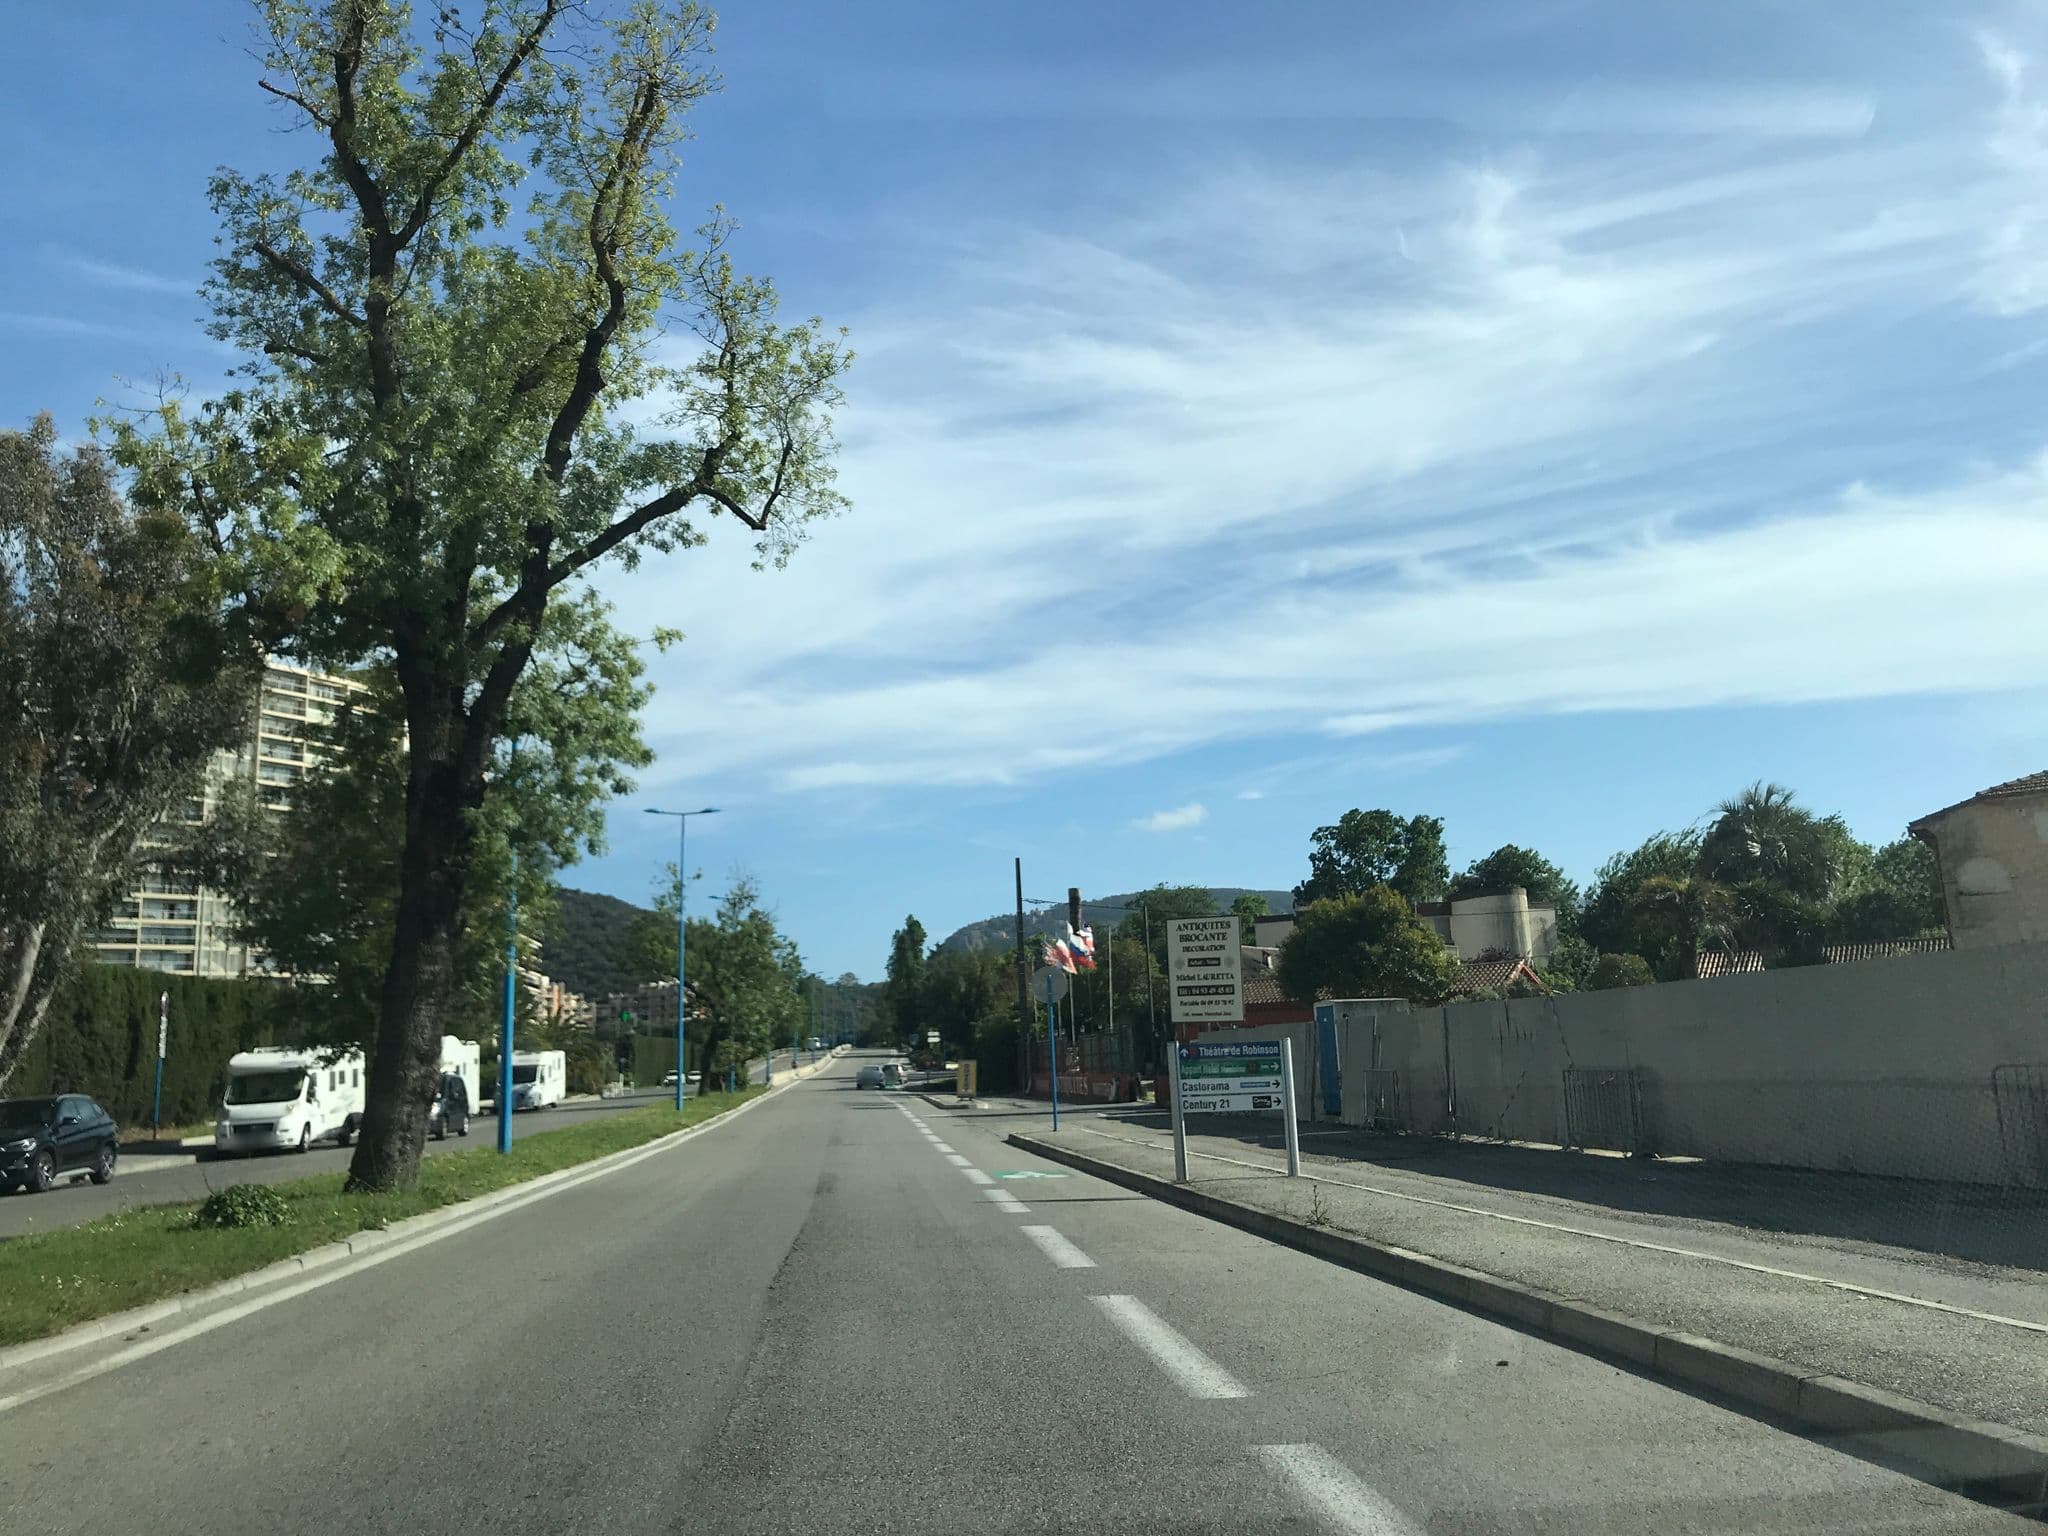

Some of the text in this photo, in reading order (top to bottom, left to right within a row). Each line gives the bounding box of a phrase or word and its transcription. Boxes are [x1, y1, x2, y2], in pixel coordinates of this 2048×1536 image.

[1176, 921, 1231, 931] ANTIQUITES
[1179, 932, 1228, 942] BROCANTE
[1197, 972, 1234, 980] LAURETTA
[1231, 1046, 1240, 1055] de
[1242, 1045, 1279, 1055] Robinson
[1182, 1082, 1230, 1092] Castorama
[1183, 1099, 1230, 1110] Century 21
